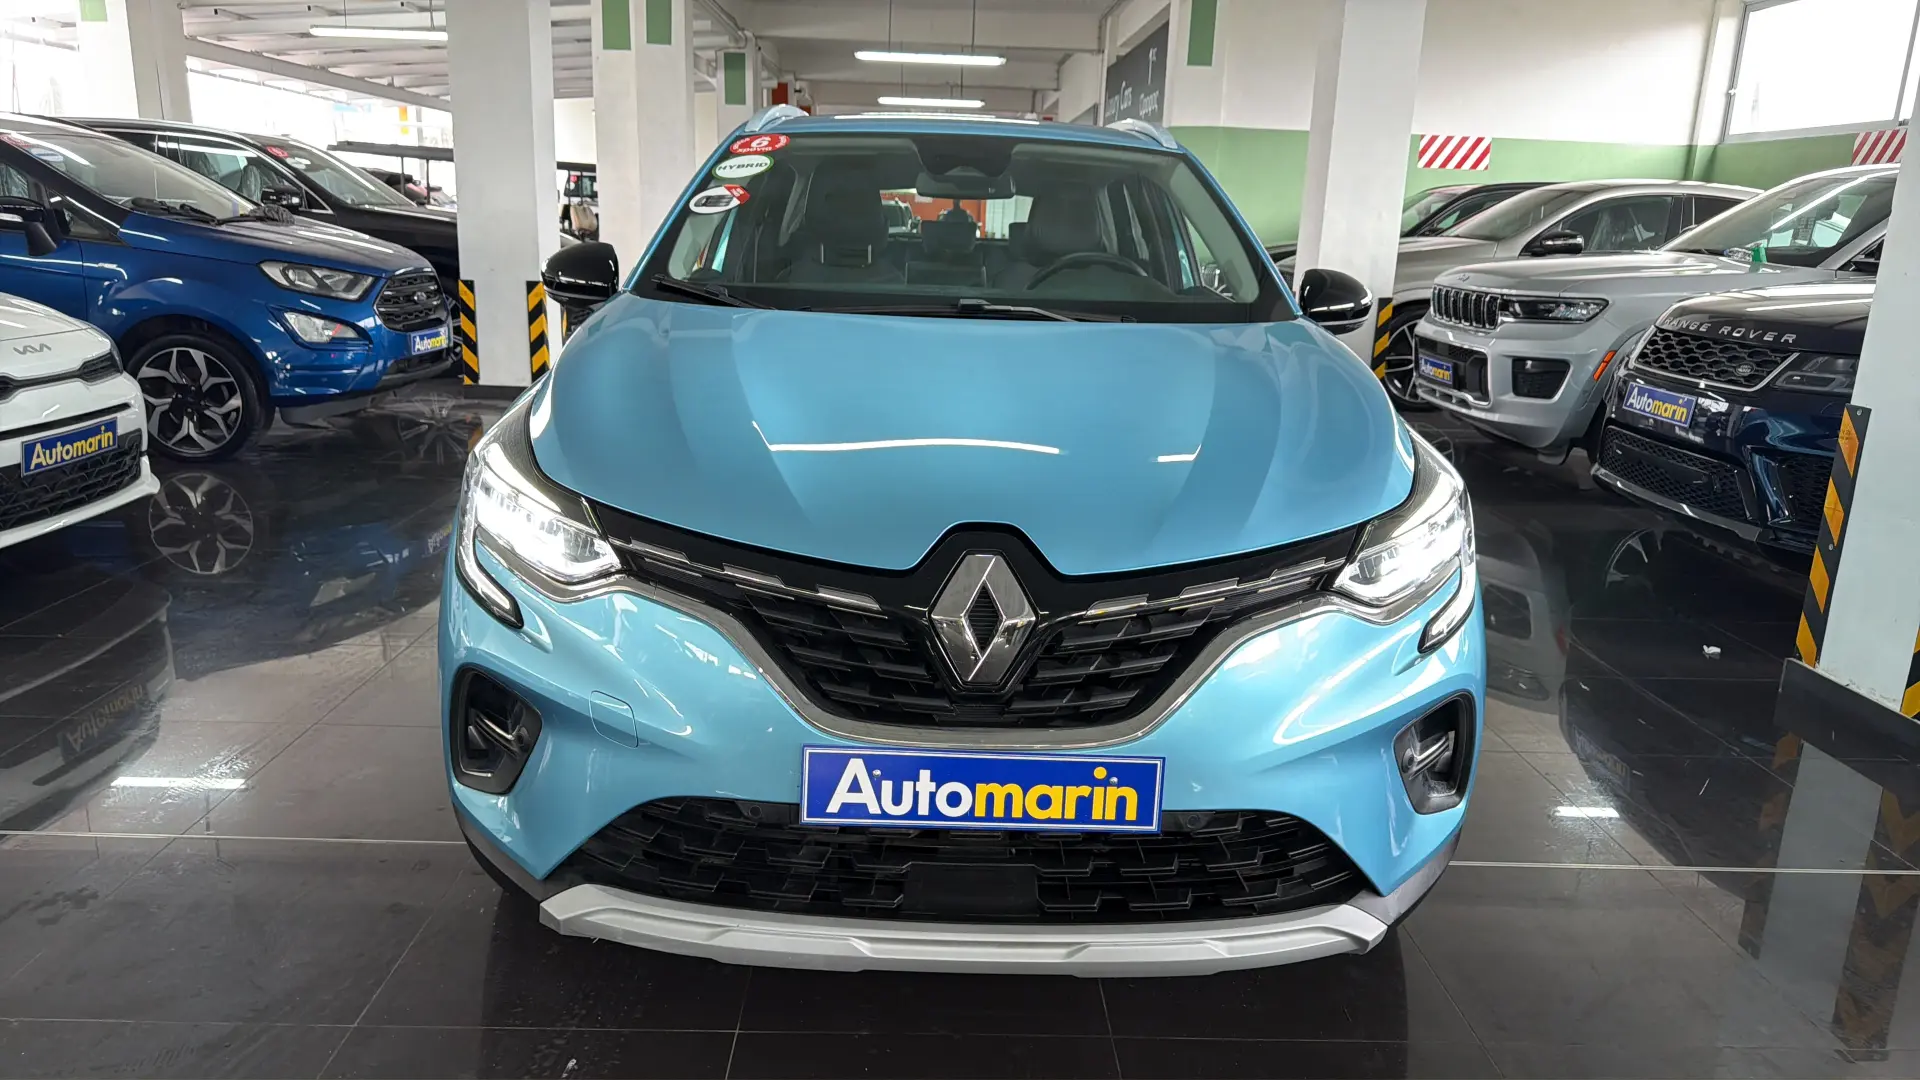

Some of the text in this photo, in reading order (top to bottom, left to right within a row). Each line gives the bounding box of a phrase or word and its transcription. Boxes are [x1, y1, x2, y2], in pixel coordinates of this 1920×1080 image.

[751, 136, 772, 148] 6
[717, 162, 768, 171] HYBRID
[1663, 316, 1797, 343] RANGE ROVER
[1627, 387, 1688, 422] Automarin
[30, 425, 114, 470] Automarin
[826, 758, 1138, 821] Automarin
